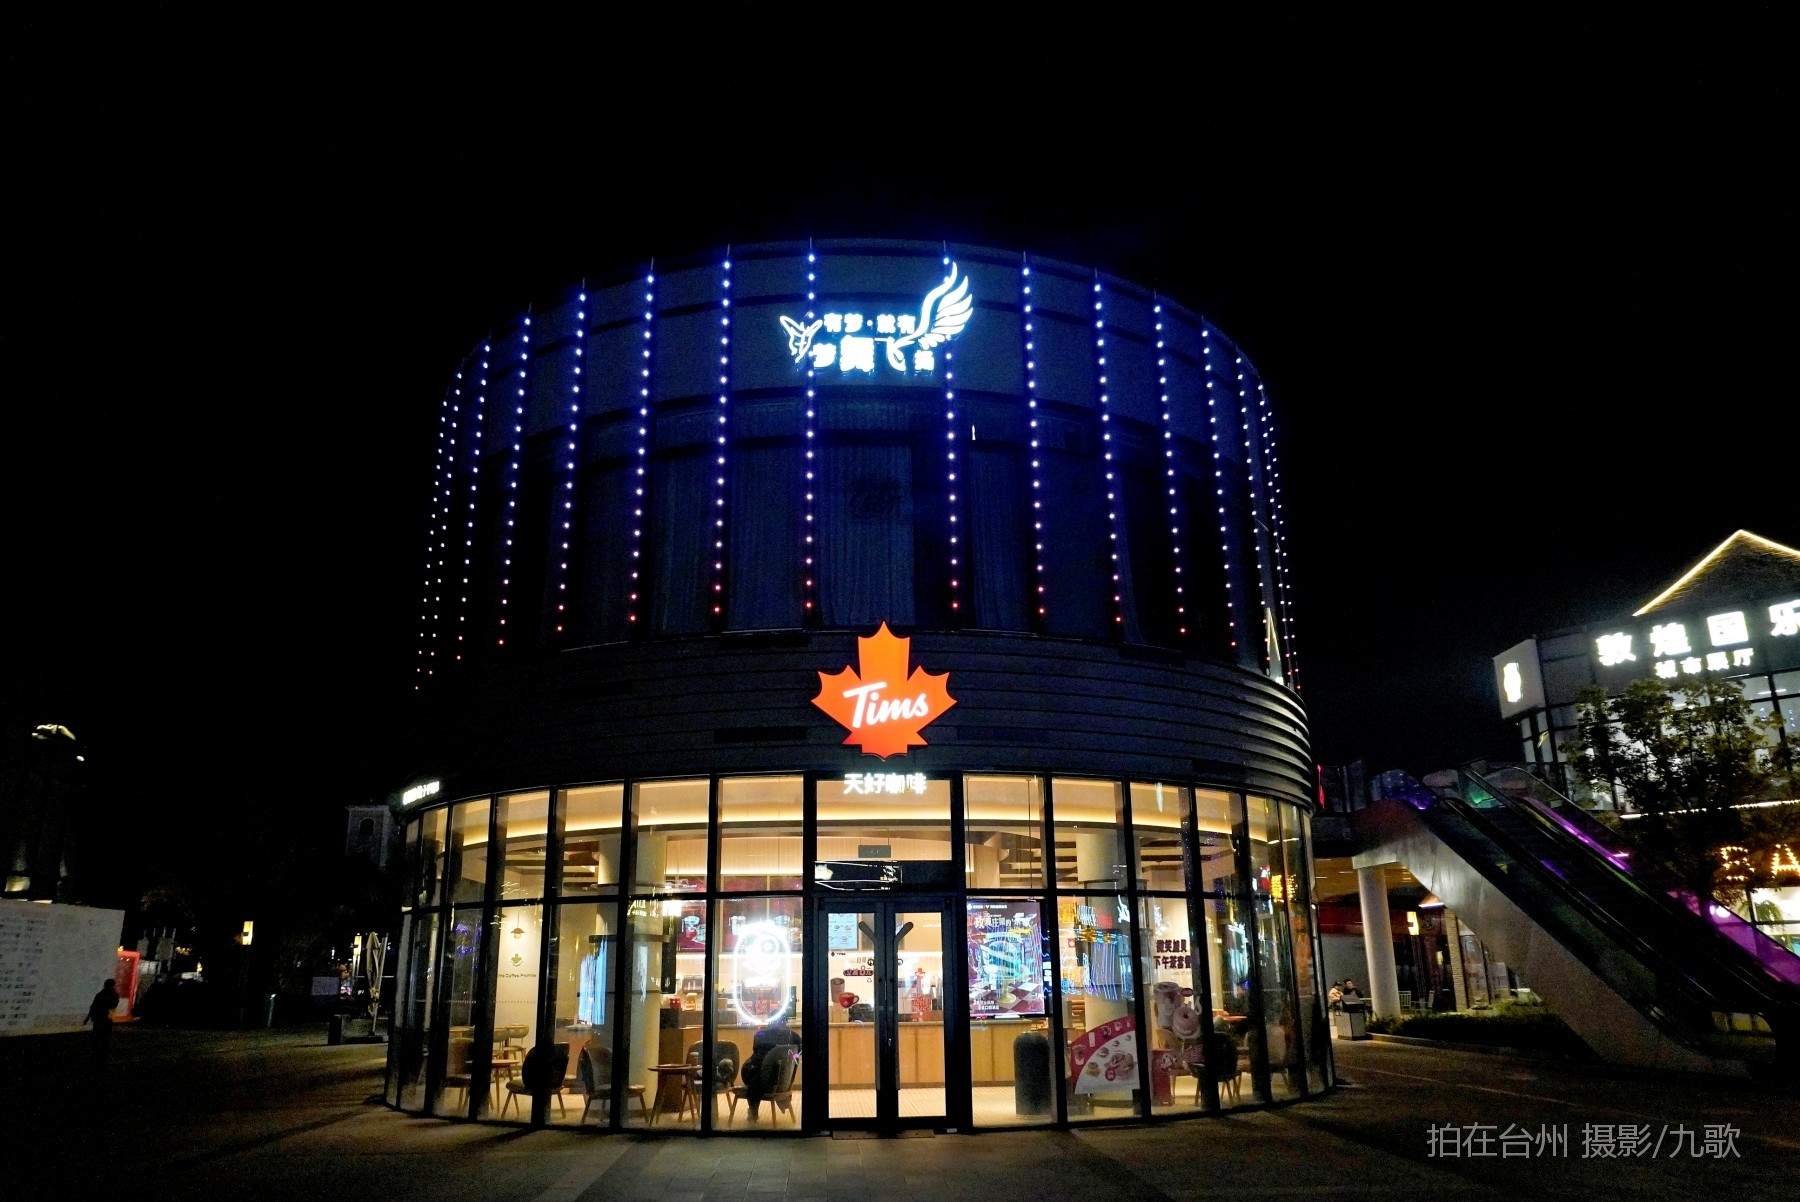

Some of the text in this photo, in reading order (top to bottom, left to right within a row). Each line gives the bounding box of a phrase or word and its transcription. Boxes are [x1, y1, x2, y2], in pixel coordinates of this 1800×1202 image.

[843, 681, 929, 729] Tims
[843, 772, 927, 795] 天好咖啡
